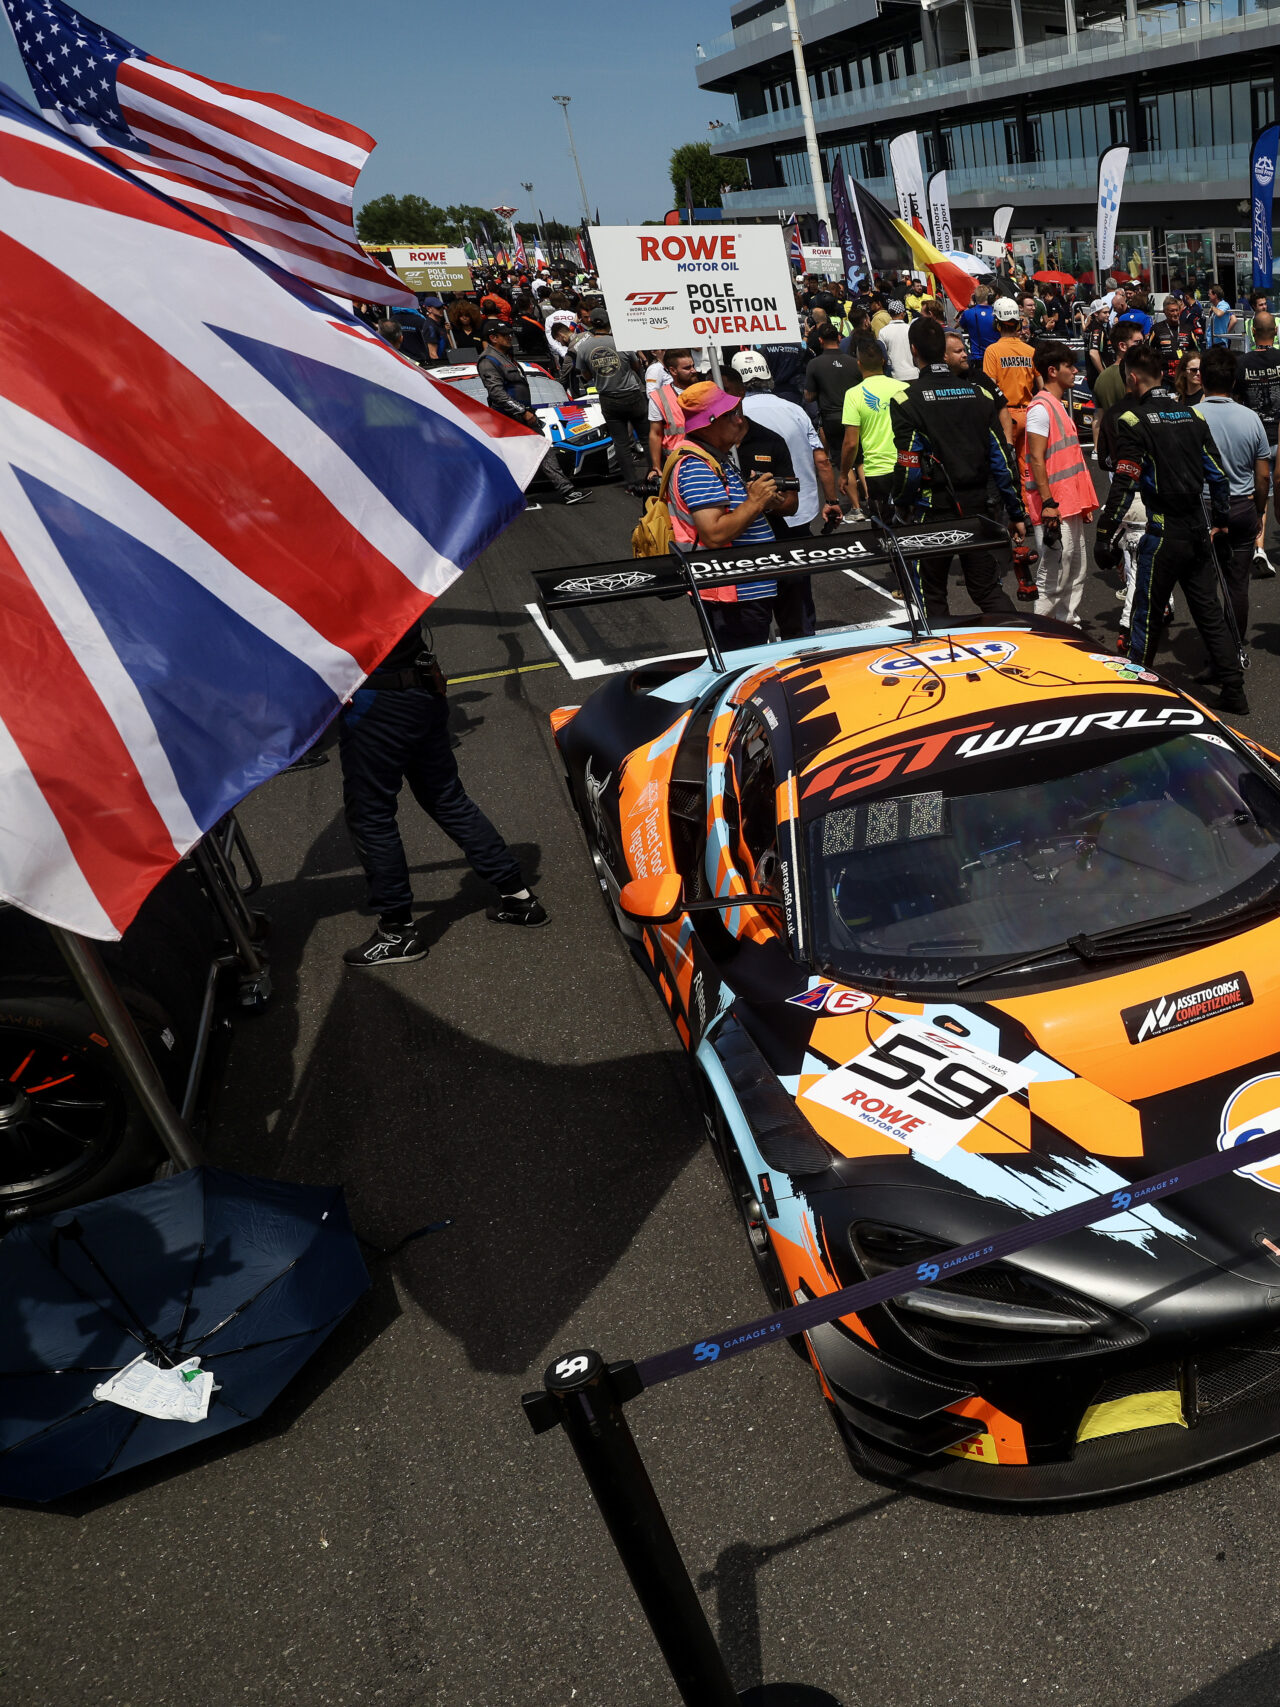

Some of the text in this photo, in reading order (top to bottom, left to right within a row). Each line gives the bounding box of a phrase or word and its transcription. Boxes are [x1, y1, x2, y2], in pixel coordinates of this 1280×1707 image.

[933, 203, 943, 250] alkenhorst
[409, 252, 446, 261] ROWE
[637, 235, 736, 261] ROWE
[977, 242, 983, 251] 5
[677, 262, 740, 272] MOTOR OIL
[686, 283, 735, 298] POLE
[689, 297, 777, 314] POSITION
[649, 317, 668, 325] aws
[692, 314, 787, 335] OVERALL
[740, 367, 753, 375] UDG
[1000, 357, 1033, 368] MARSHAL
[1245, 368, 1257, 379] ALL
[691, 541, 868, 575] Direct Food
[881, 640, 1009, 672] Gulf
[955, 708, 1205, 758] WORLD
[629, 822, 649, 880] Ingredie
[645, 808, 668, 877] Direct Food
[780, 861, 795, 938] garage59.co.uk
[1176, 990, 1241, 1022] COMPETIZIONE
[1177, 980, 1240, 1010] ASSETTO CORSA
[1162, 1023, 1183, 1033] OFFICIAL
[1190, 1015, 1206, 1023] WORLD
[1206, 1006, 1232, 1017] CHALLENGE
[845, 1033, 1009, 1120] 59
[988, 1063, 1008, 1076] aws
[841, 1089, 926, 1134] ROWE
[859, 1112, 908, 1140] MOTOR OIL
[1111, 1175, 1180, 1210] 59 GARAGE 59
[915, 1245, 994, 1281] 59 GARAGE 59
[693, 1322, 782, 1362] 59 GARAGE 59
[555, 1355, 589, 1380] 59
